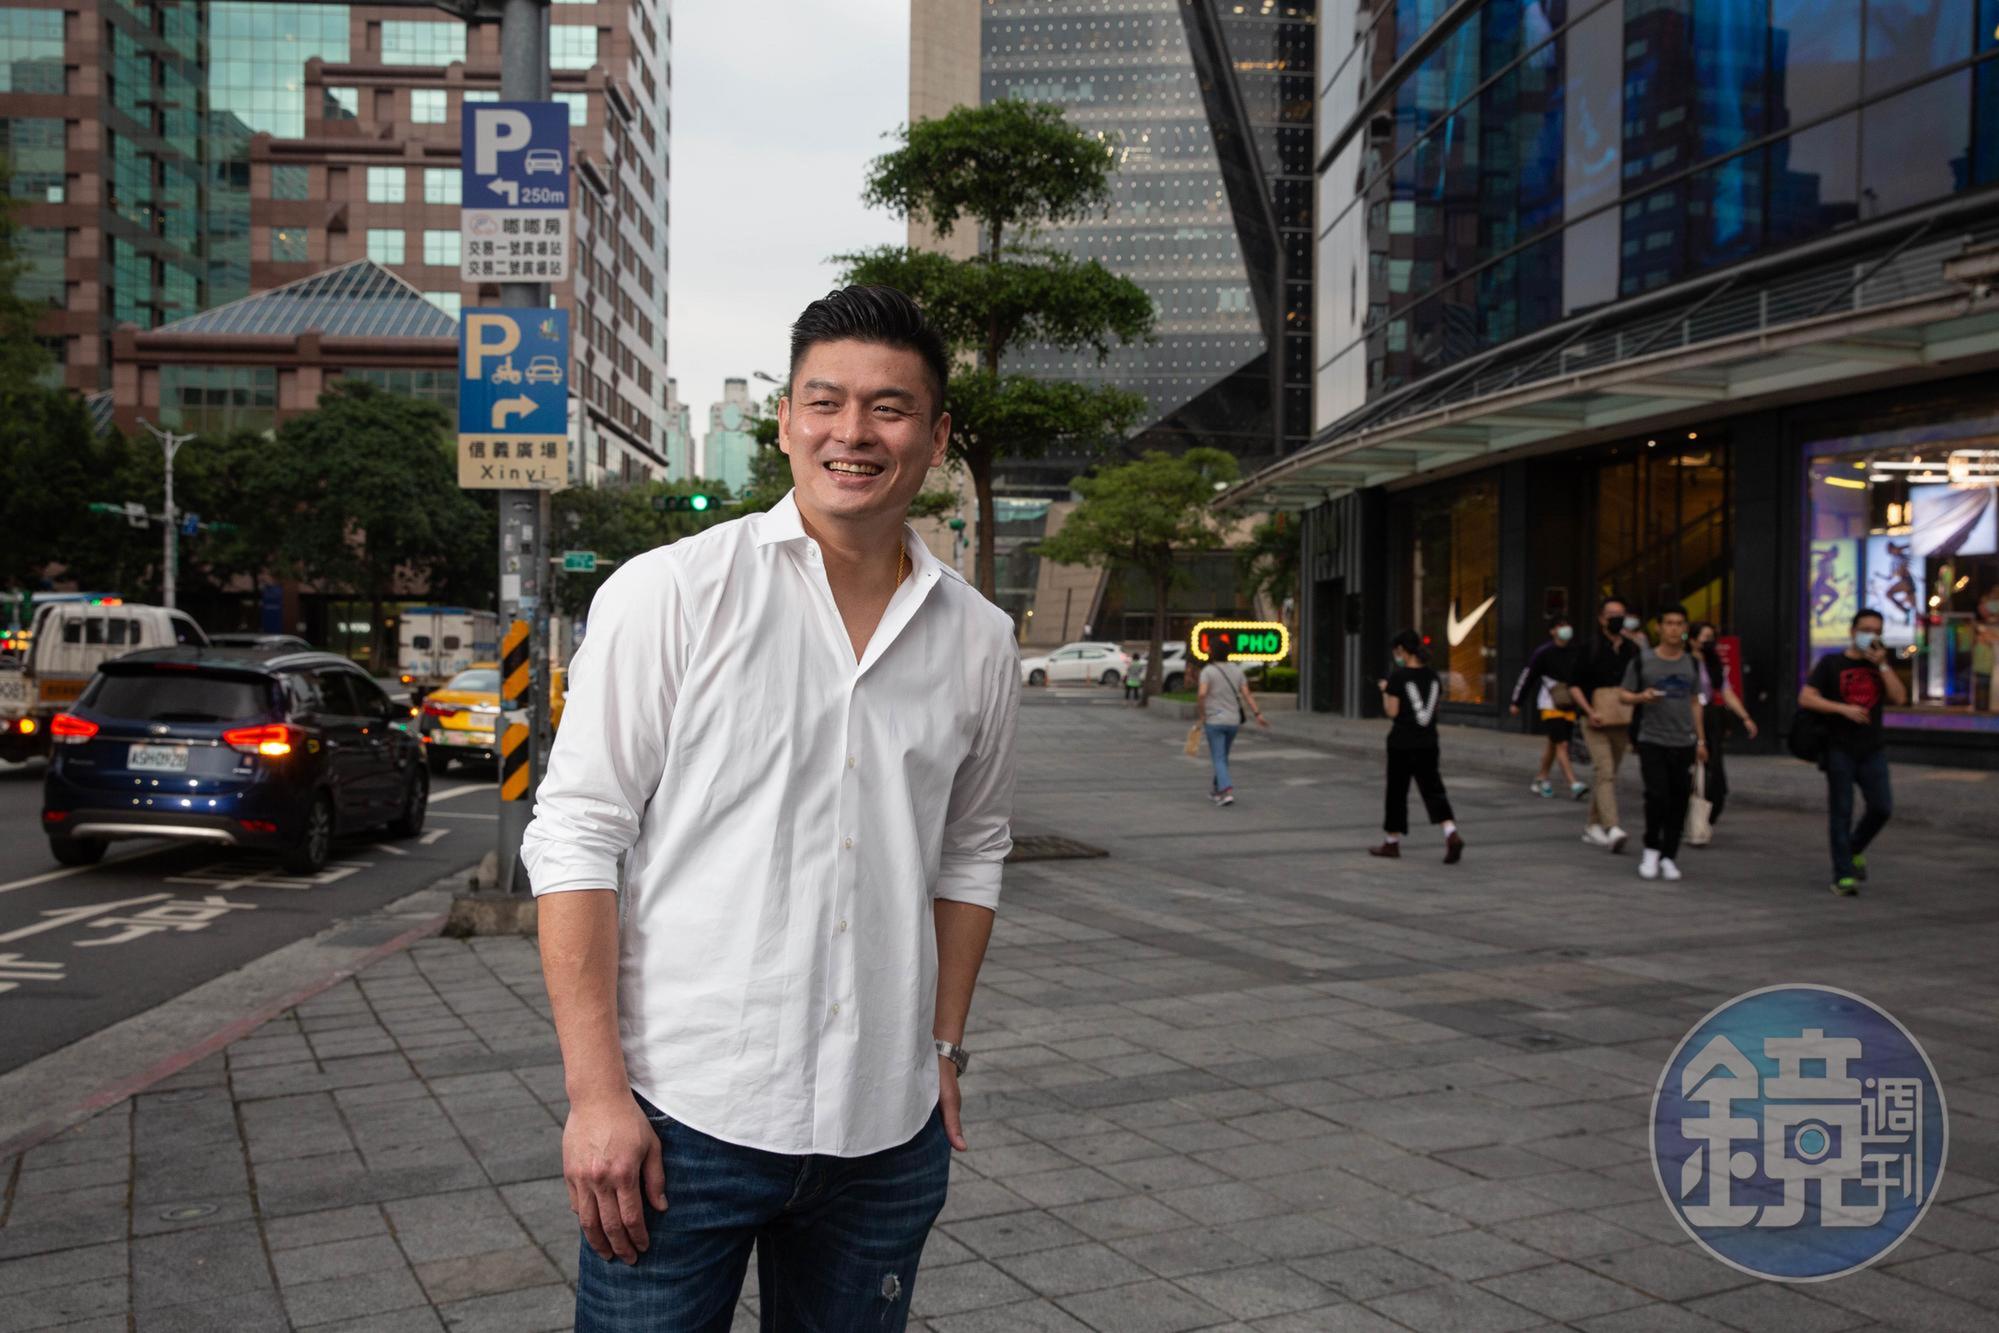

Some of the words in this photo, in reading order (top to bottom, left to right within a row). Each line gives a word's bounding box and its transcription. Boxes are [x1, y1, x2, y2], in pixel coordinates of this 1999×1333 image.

[475, 109, 532, 175] P
[521, 188, 565, 203] 250m
[466, 314, 521, 380] P
[469, 441, 558, 459] 信義廣場
[481, 465, 546, 481] Xinyi
